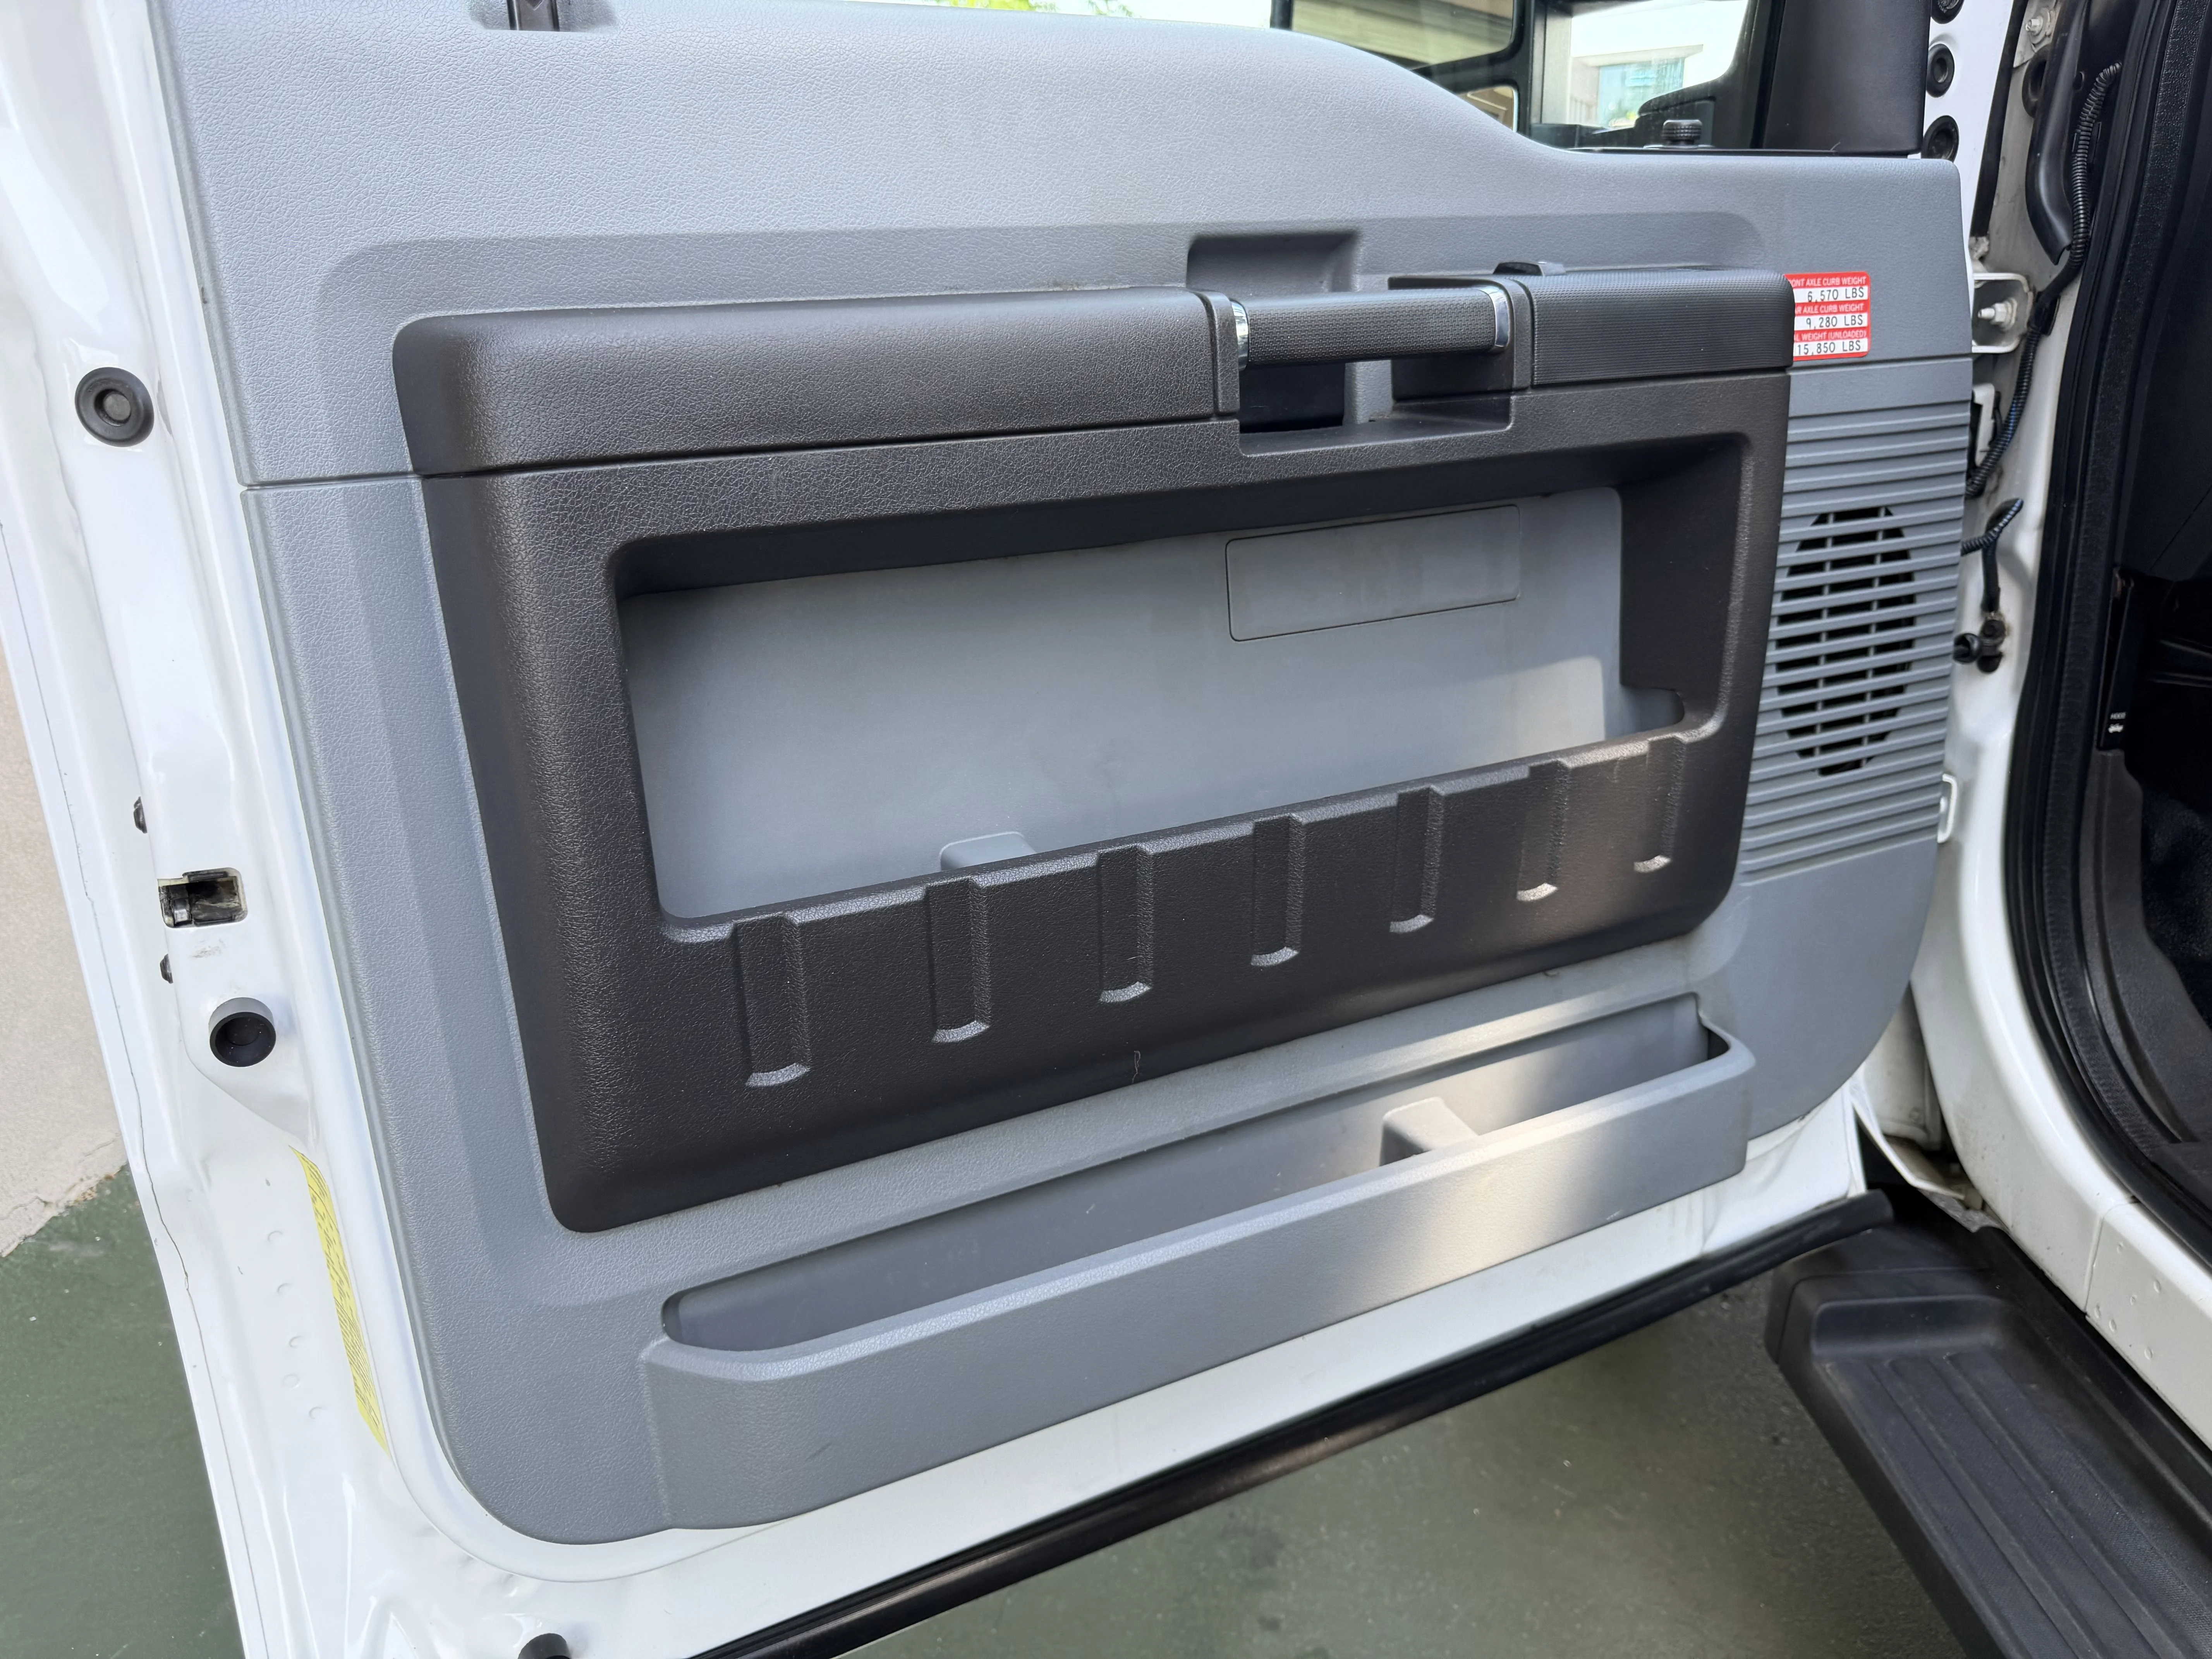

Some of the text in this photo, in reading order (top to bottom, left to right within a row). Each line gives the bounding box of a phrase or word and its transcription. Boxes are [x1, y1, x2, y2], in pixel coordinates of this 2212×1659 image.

[1788, 275, 1867, 287] ONT AXLE CURB WEIGHT
[1807, 287, 1864, 303] 6,570 LBS
[1803, 305, 1819, 314] AXLE
[1820, 304, 1838, 313] CURB
[1839, 303, 1864, 312] WEIGHT
[1806, 314, 1863, 330] 9,280 LBS
[1801, 332, 1827, 341] WEIGHT
[1828, 330, 1866, 340] (UNLOADED)
[1798, 340, 1861, 356] 15,850 LBS
